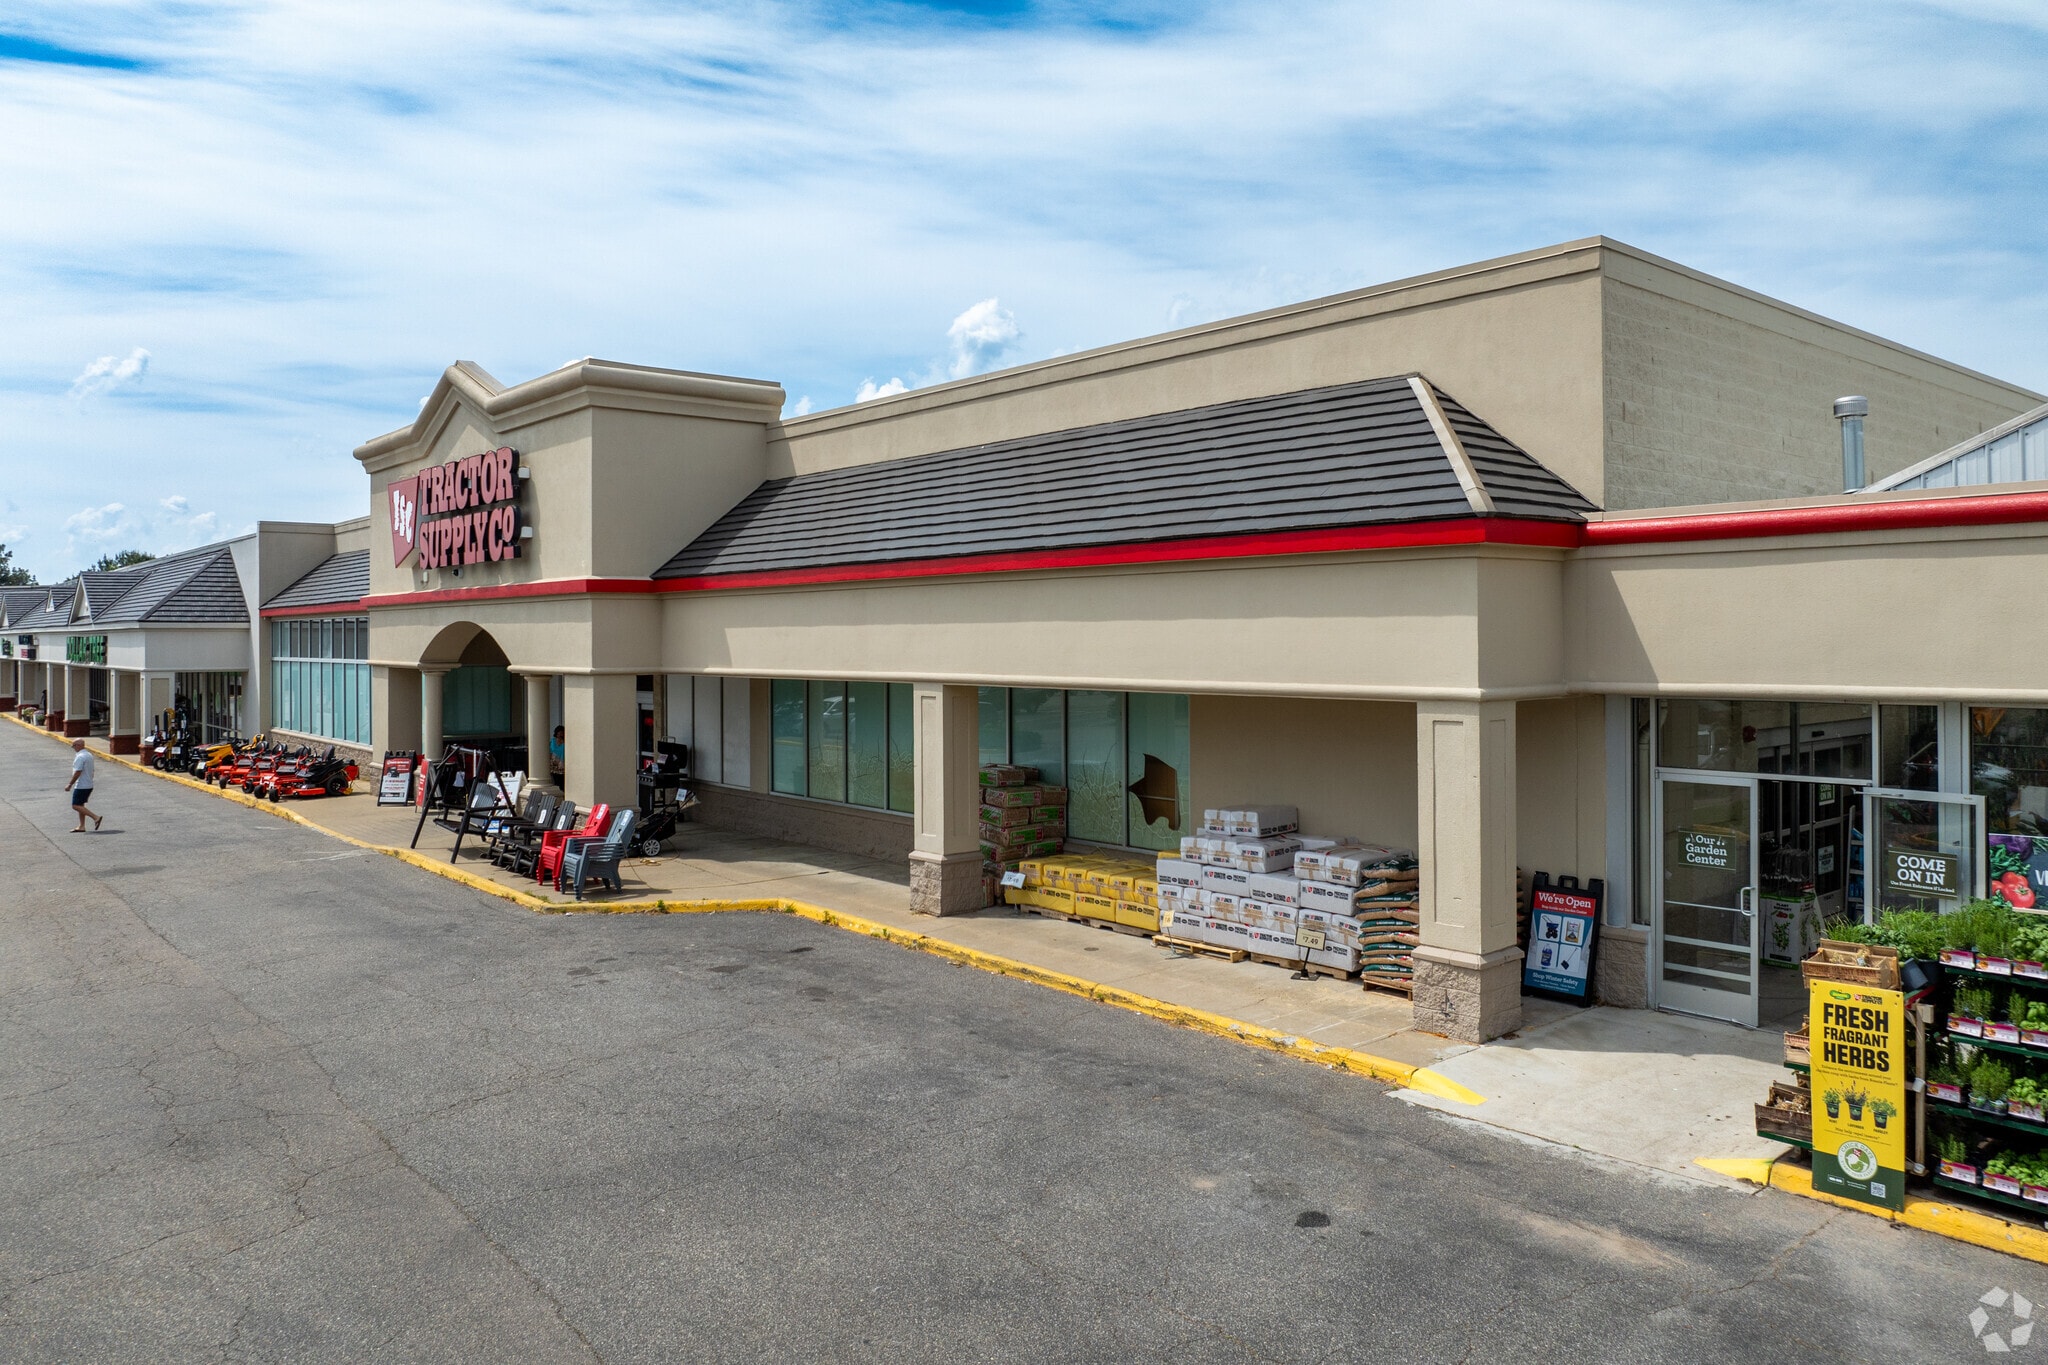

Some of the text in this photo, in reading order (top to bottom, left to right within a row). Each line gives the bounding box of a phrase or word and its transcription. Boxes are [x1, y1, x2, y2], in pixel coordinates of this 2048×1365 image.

[419, 447, 514, 515] TRACTOR
[419, 511, 488, 570] SUPPLY
[1695, 834, 1715, 845] Our
[1685, 843, 1727, 856] Garden
[1686, 853, 1727, 866] Center
[1896, 855, 1946, 872] COME
[1897, 868, 1945, 885] ON IN
[1538, 892, 1591, 909] We're Open
[1824, 1002, 1888, 1033] FRESH
[1824, 1027, 1888, 1048] FRAGRANT
[1824, 1042, 1889, 1072] HERBS
